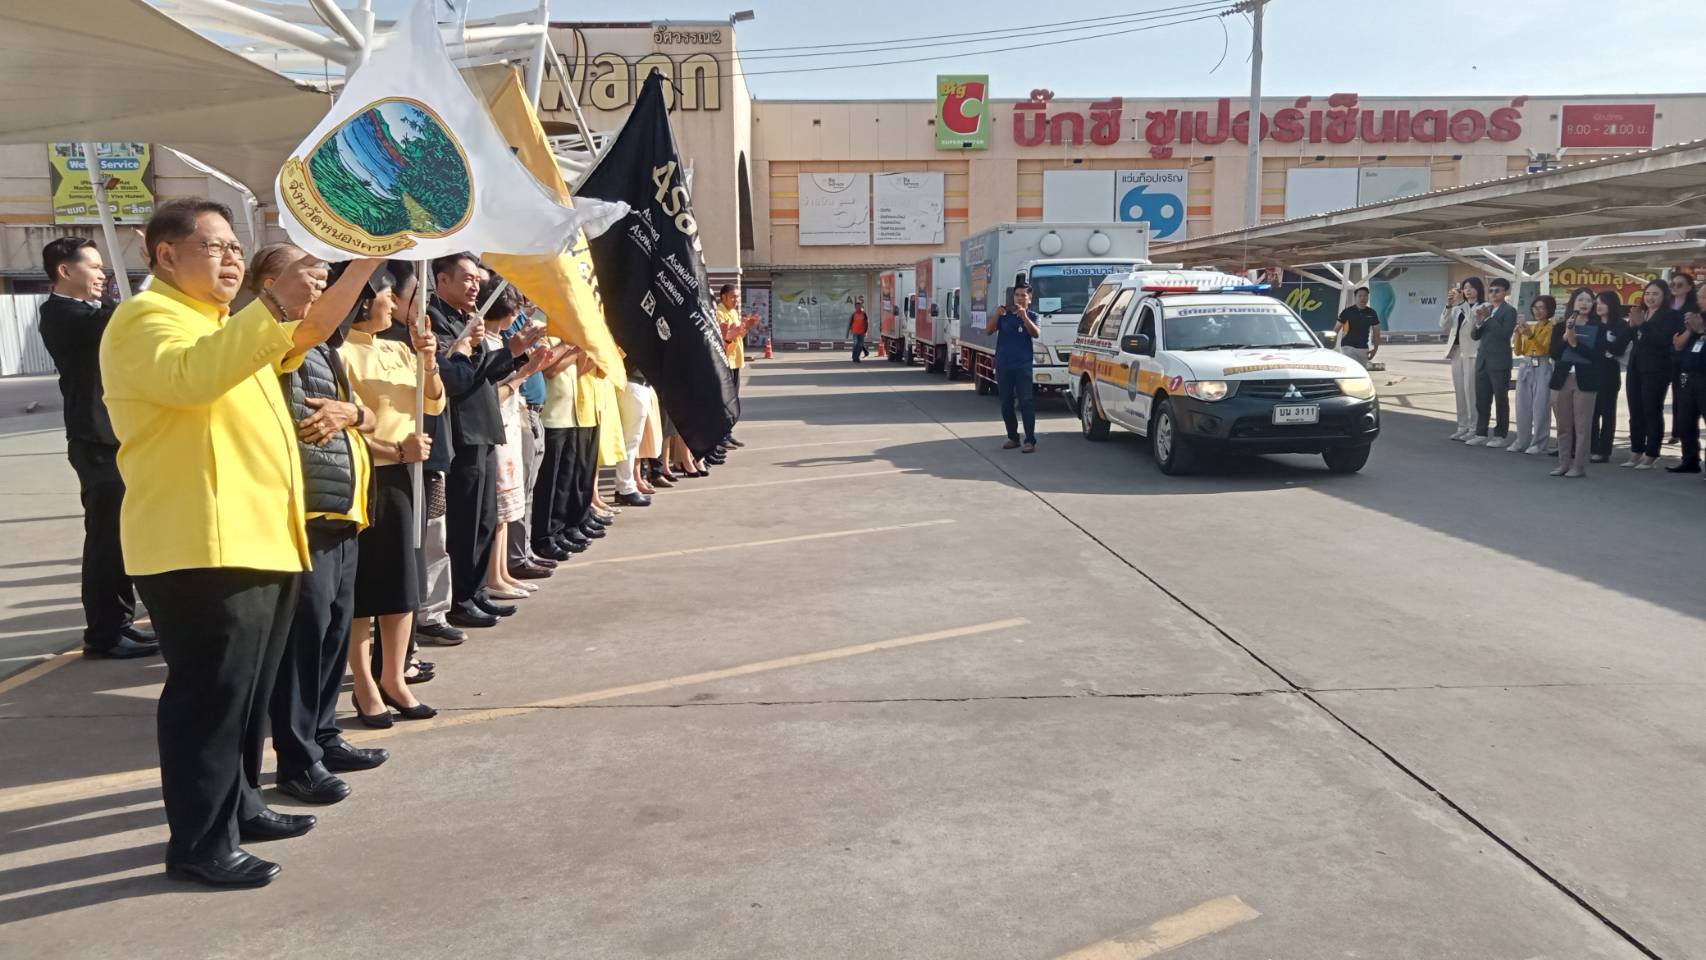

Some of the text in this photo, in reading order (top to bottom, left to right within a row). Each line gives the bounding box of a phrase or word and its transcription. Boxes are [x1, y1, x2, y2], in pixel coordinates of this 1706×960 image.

[653, 26, 722, 45] อัศวรรณ2
[941, 80, 986, 135] Big C
[1013, 88, 1529, 161] บิ๊กซี ซูเปอร์เซ็นเตอร์
[100, 159, 140, 169] Service
[1121, 172, 1184, 183] แว่นท็อปเจริญ
[666, 253, 699, 290] Asawann
[656, 270, 685, 306] Asawann
[798, 296, 818, 306] AIS
[846, 295, 865, 305] AIS
[1420, 297, 1437, 305] WAY
[689, 311, 709, 332] PTT
[1294, 407, 1315, 416] 3111
